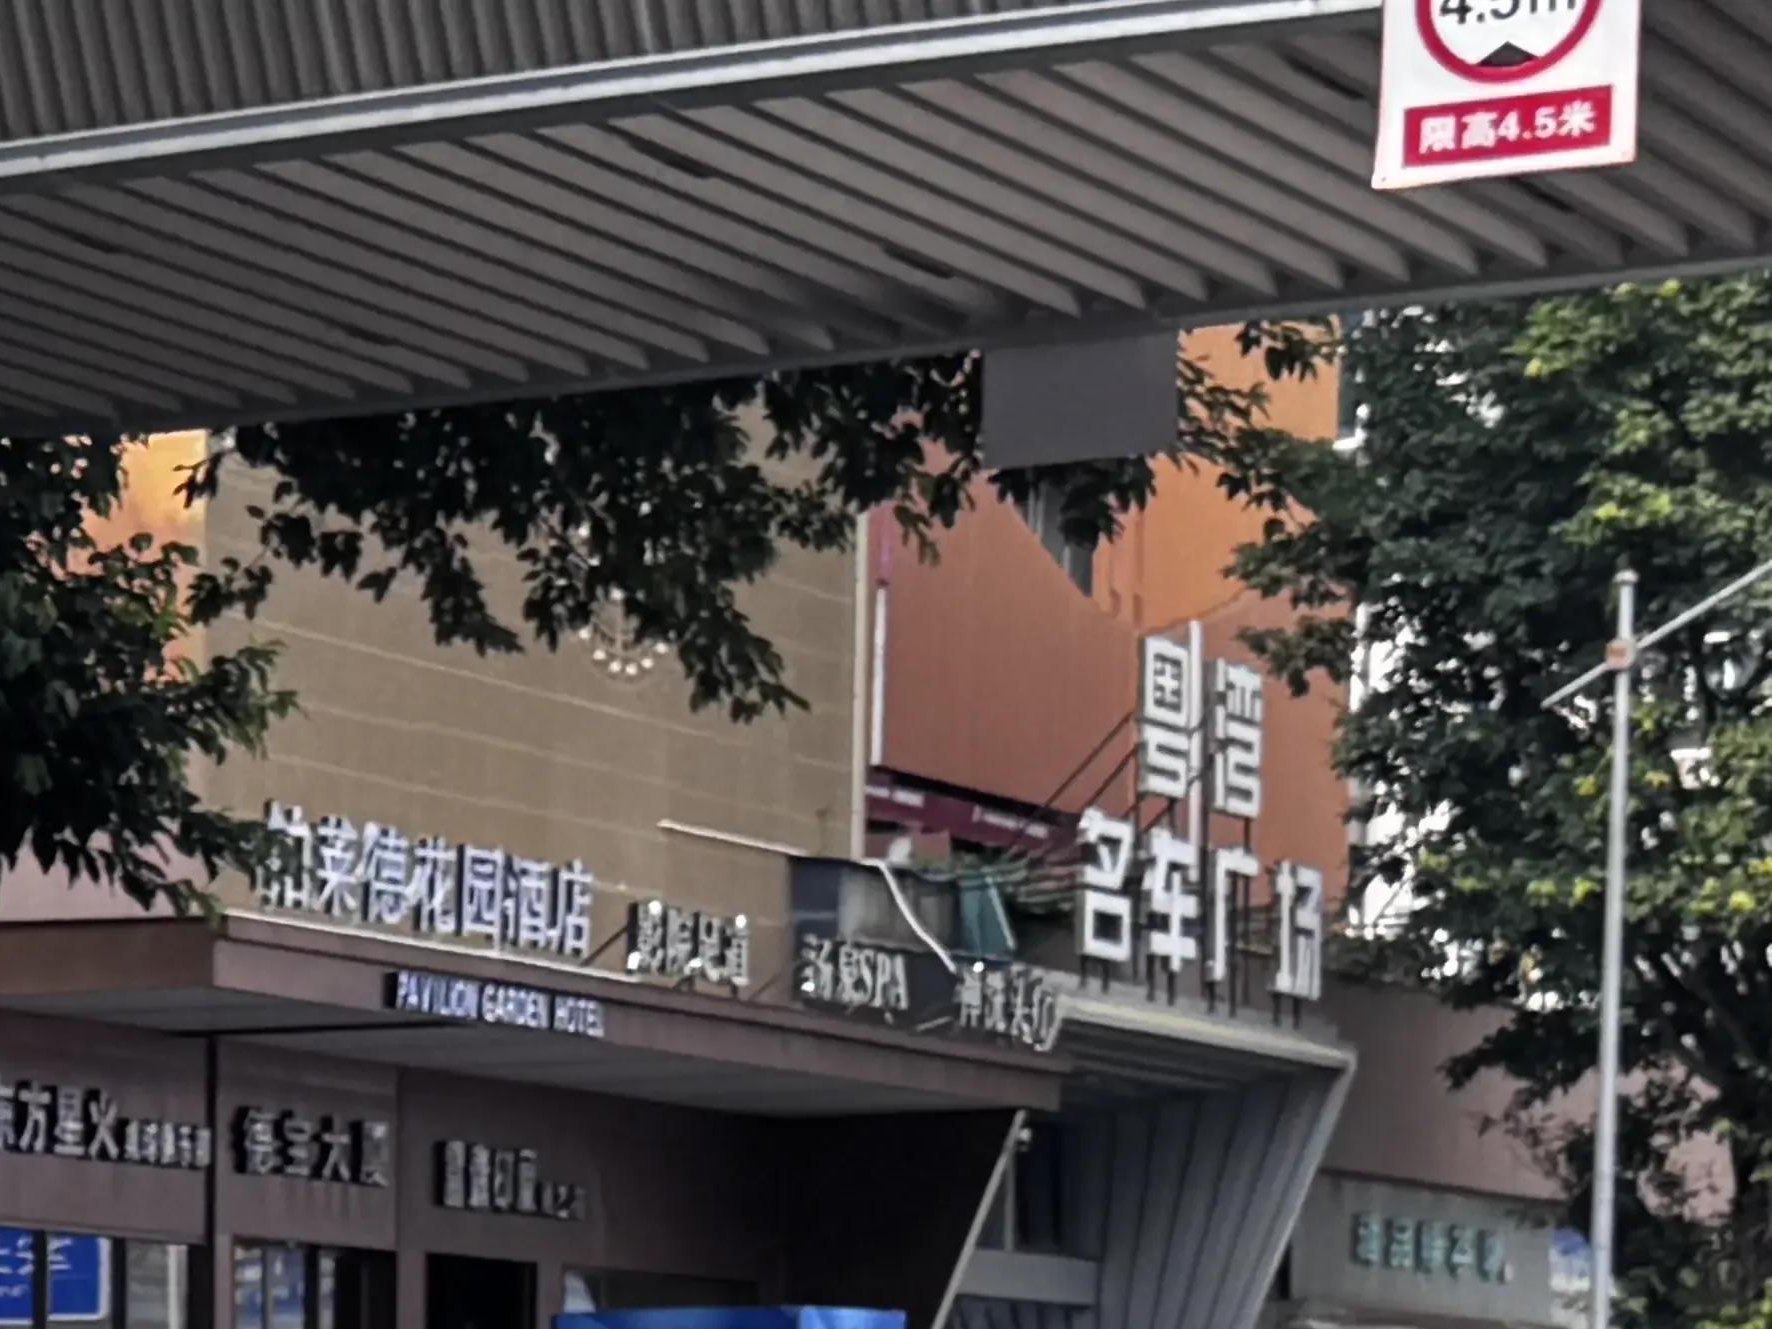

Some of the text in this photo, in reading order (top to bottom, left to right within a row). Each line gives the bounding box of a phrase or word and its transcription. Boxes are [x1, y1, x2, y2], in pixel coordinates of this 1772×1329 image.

[1418, 99, 1597, 154] 限高4.5米
[1078, 806, 1323, 1001] 名车广场
[396, 970, 605, 1037] PAVILION GARDEN HOTEL
